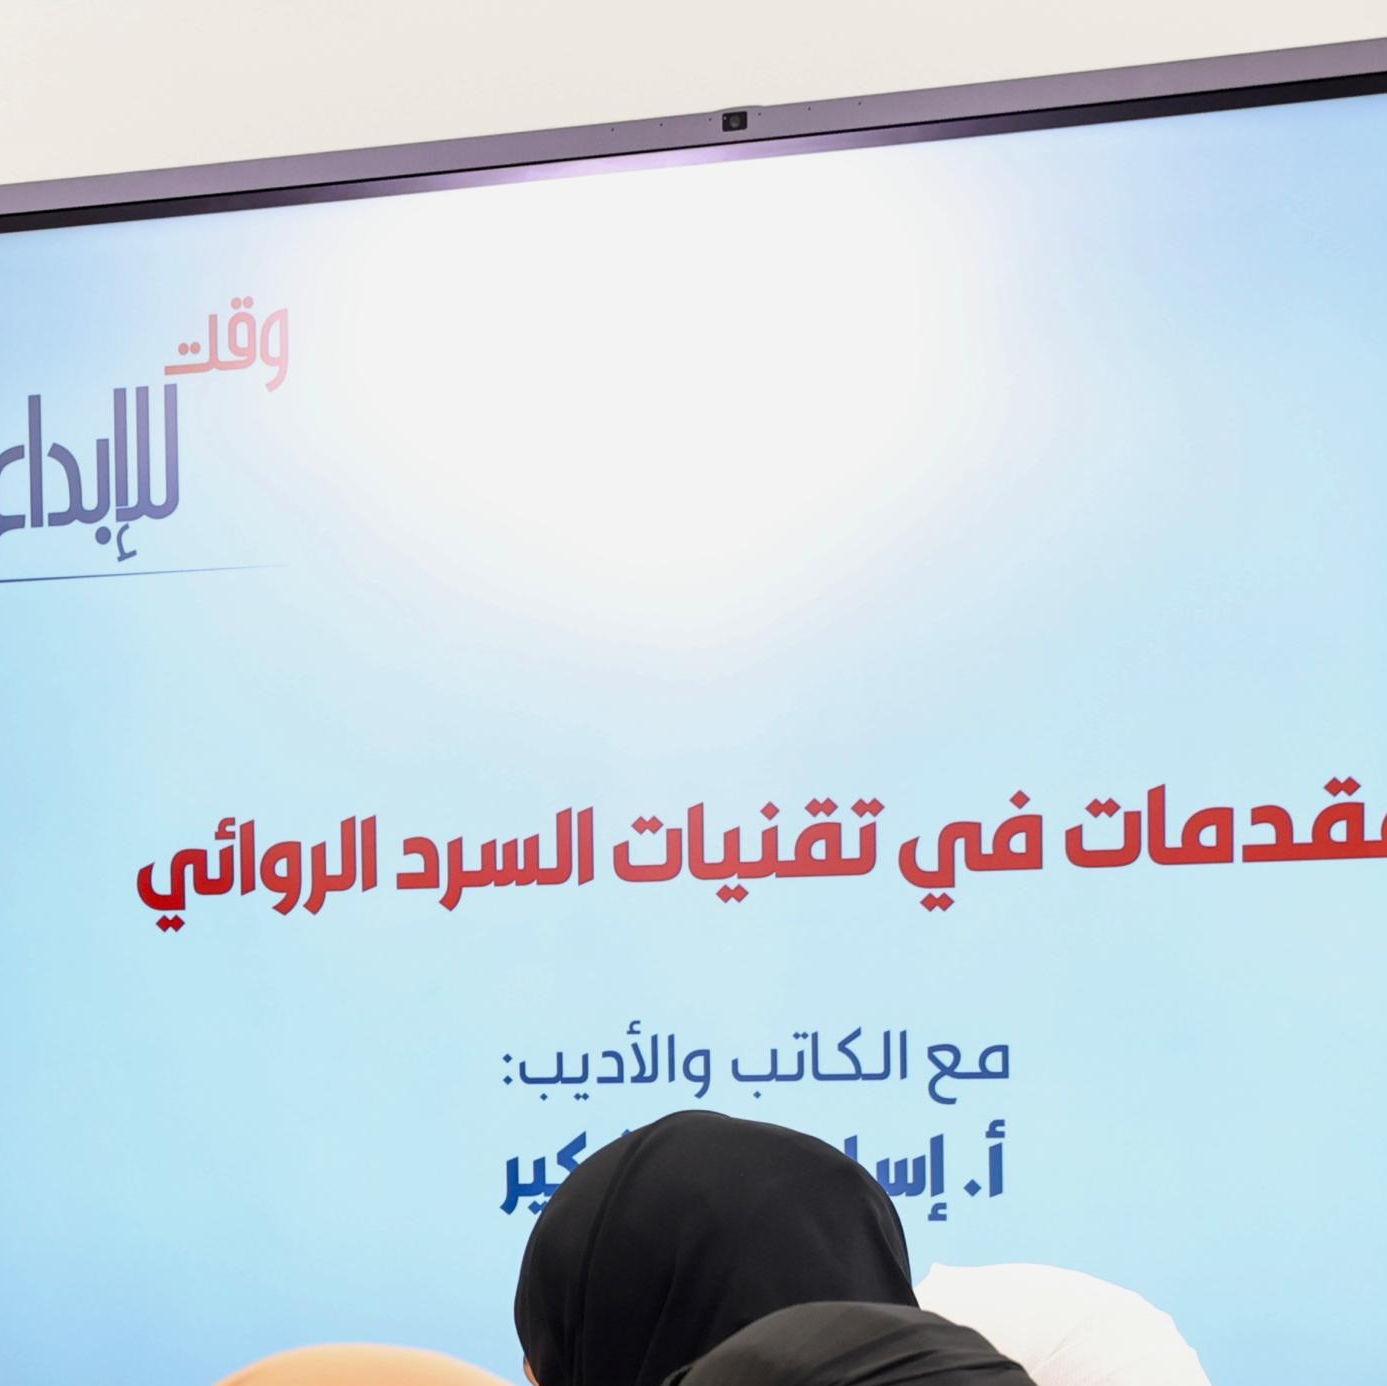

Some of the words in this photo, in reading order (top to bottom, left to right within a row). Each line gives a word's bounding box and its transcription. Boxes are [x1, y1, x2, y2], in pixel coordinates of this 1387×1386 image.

[163, 296, 290, 392] وقت
[396, 806, 595, 912] السرد
[614, 798, 885, 902] تقنيات
[899, 791, 1043, 910] في
[1065, 776, 1387, 868] قدمات
[137, 815, 377, 933] الروائي
[501, 1019, 712, 1101] والأديب:
[730, 1026, 909, 1099] الكاتب
[927, 1043, 1011, 1105] مع
